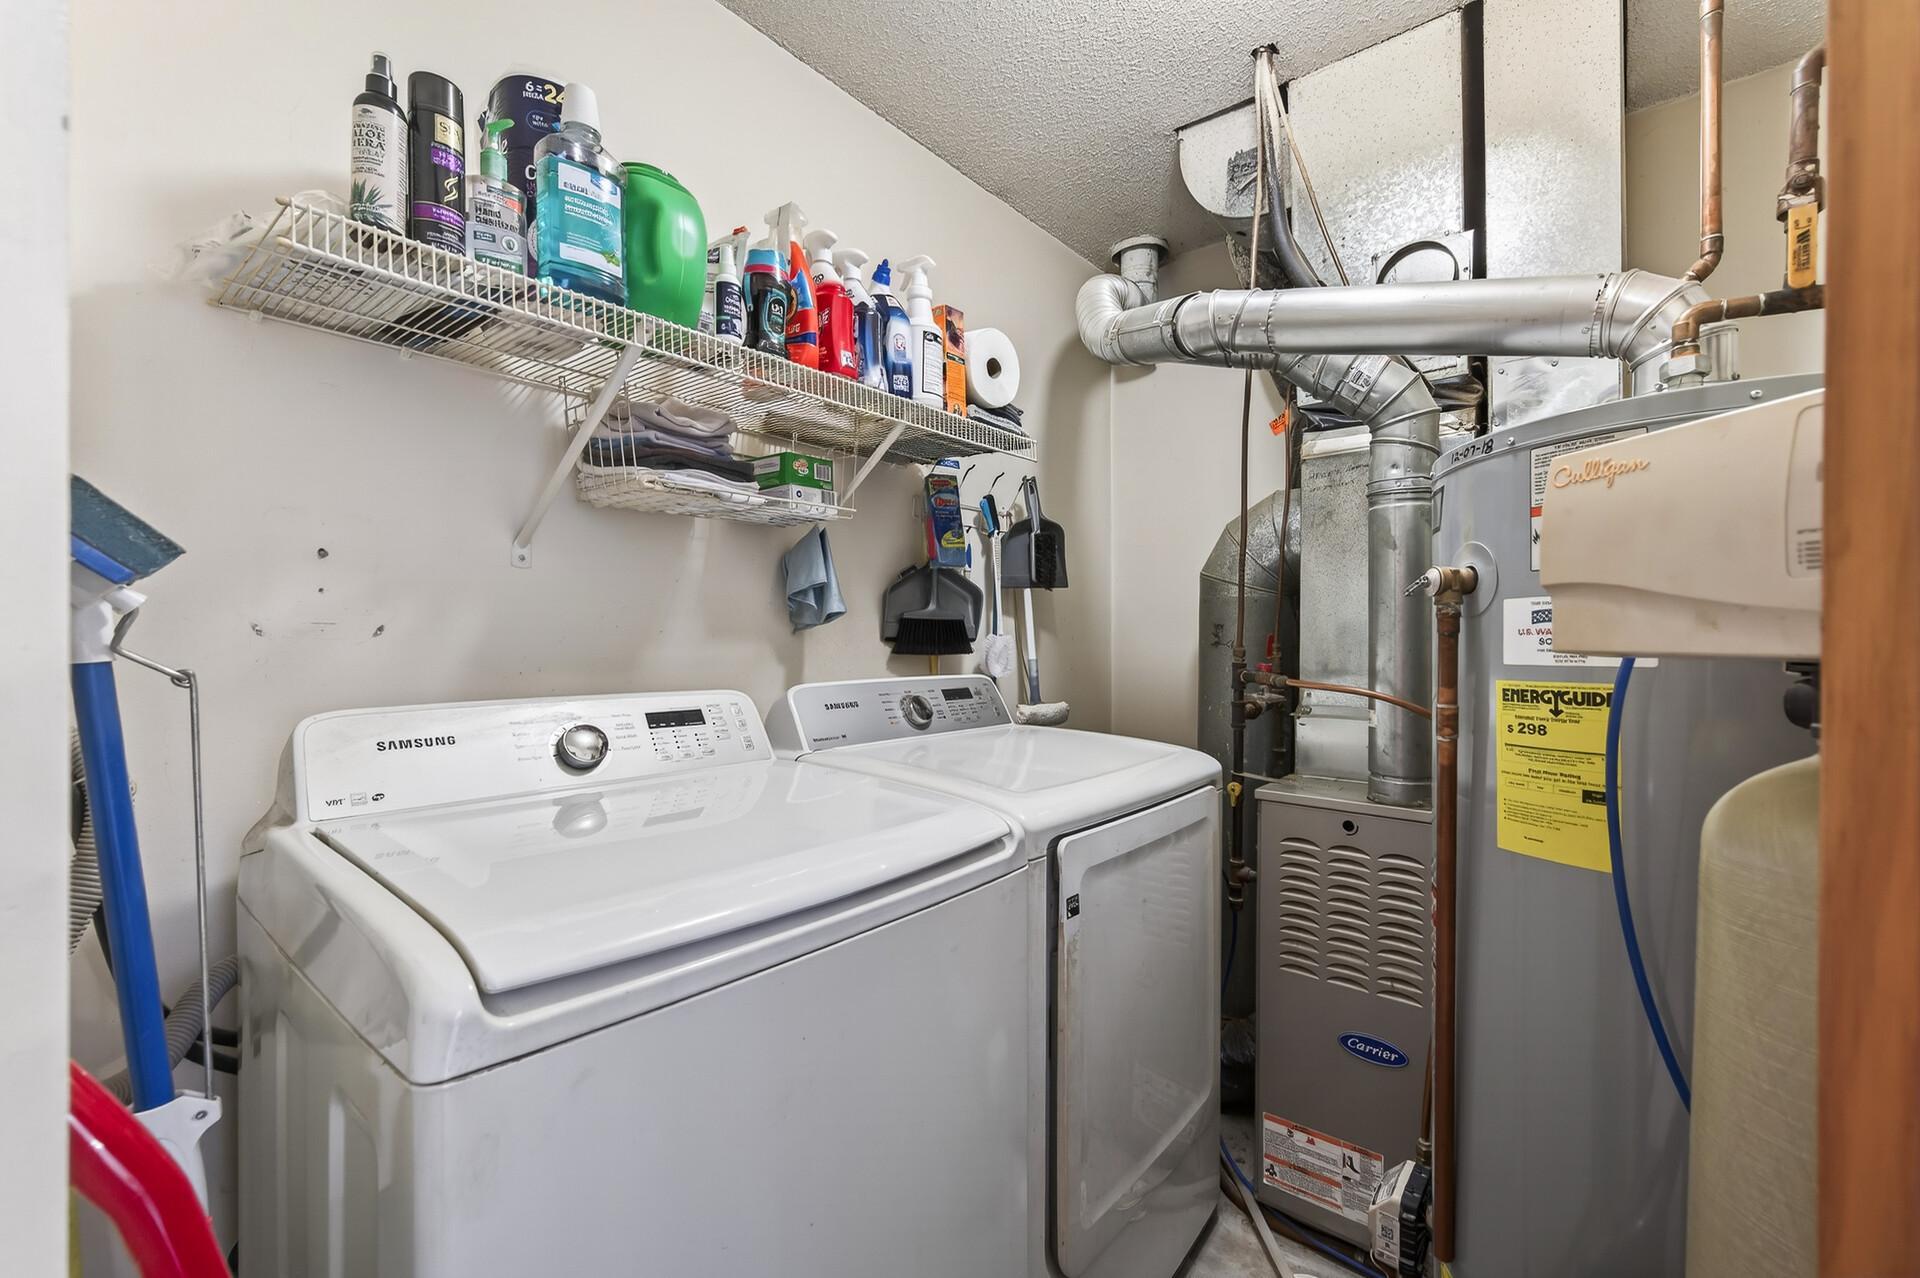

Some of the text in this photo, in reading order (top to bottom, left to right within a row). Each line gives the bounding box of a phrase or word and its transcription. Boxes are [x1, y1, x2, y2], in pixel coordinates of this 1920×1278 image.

[1451, 438, 1494, 465] 12-07-18
[1552, 457, 1650, 489] Culligan
[1517, 722, 1548, 736] 298
[376, 735, 456, 752] SAMSUNG
[1347, 1038, 1399, 1062] Carrier
